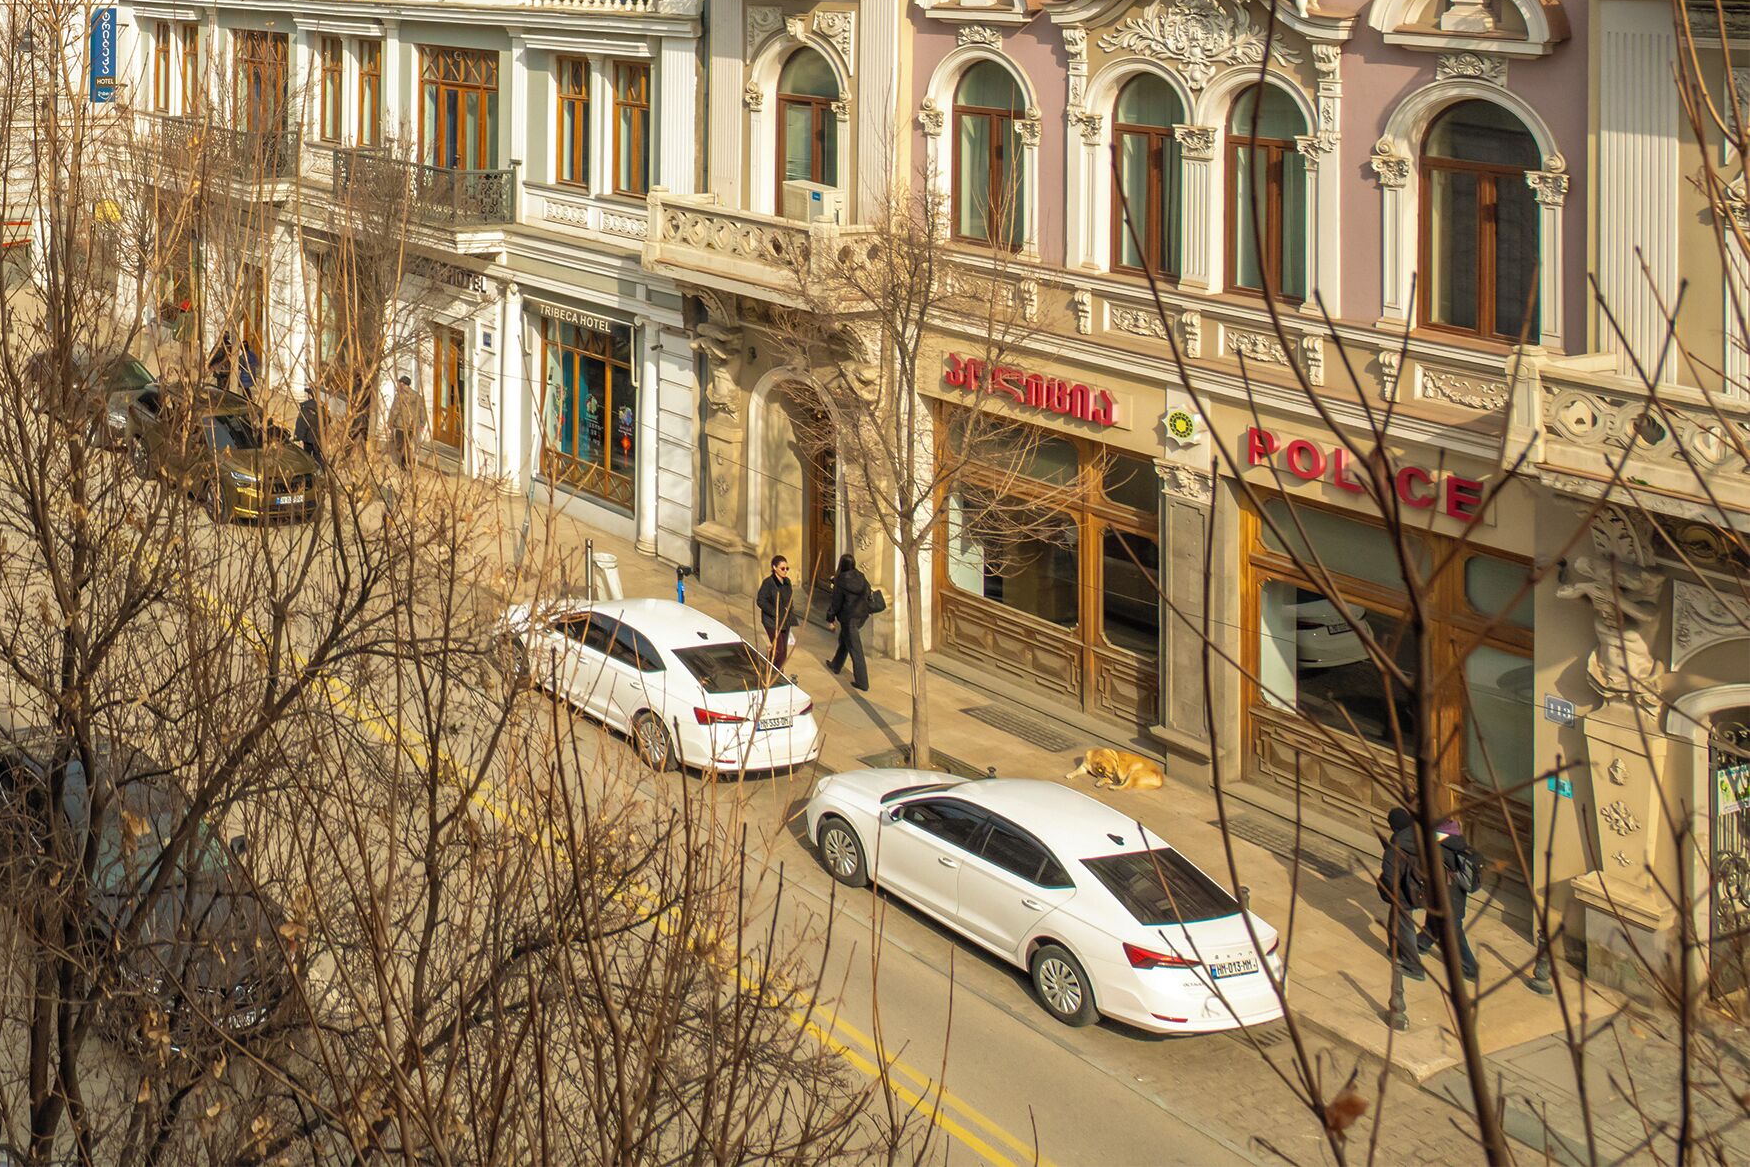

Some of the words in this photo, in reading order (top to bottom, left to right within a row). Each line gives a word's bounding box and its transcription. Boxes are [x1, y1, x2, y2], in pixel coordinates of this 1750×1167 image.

[540, 304, 579, 324] TRIBECA
[580, 314, 611, 333] HOTEL
[1248, 426, 1484, 523] POLCE
[1550, 702, 1571, 719] 113
